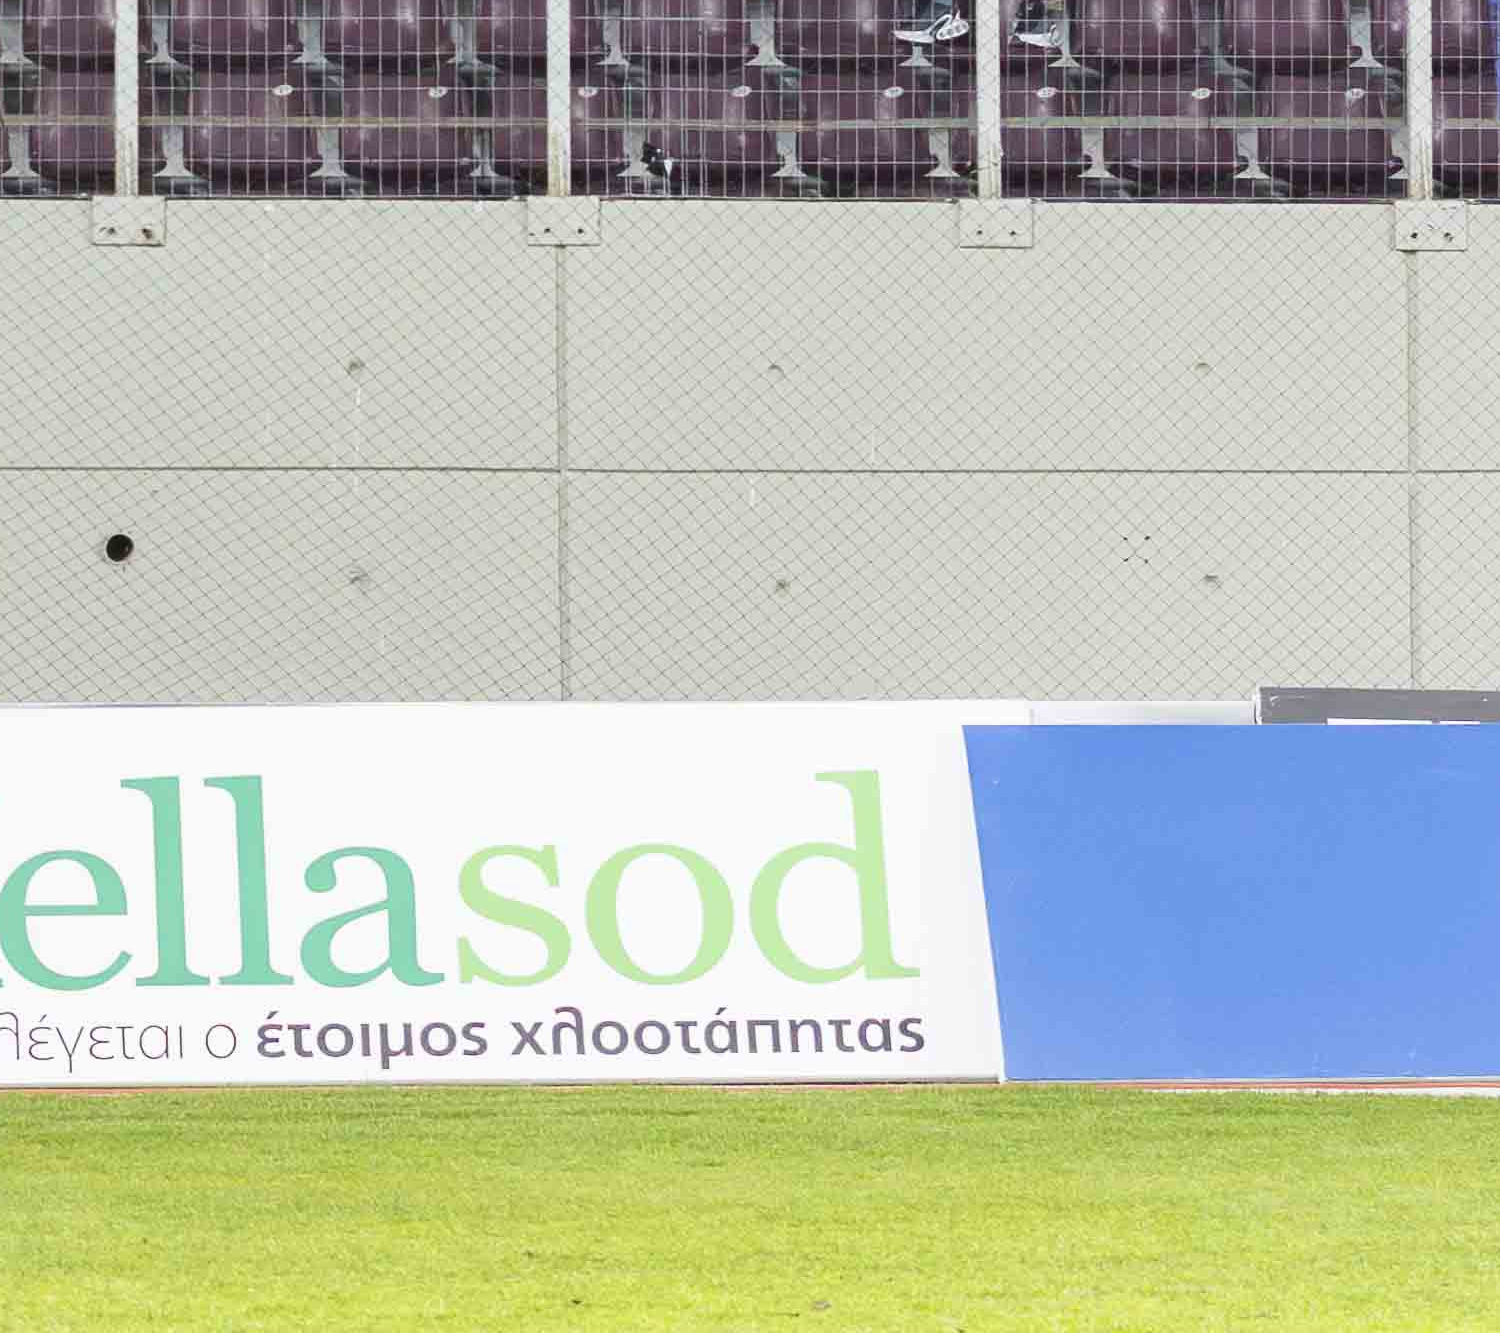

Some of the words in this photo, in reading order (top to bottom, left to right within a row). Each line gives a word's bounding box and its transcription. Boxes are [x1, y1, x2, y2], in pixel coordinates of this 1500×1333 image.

[204, 1020, 237, 1061] ο
[255, 1008, 490, 1071] έτοιμος
[512, 1001, 926, 1064] χλοοτάπητας
